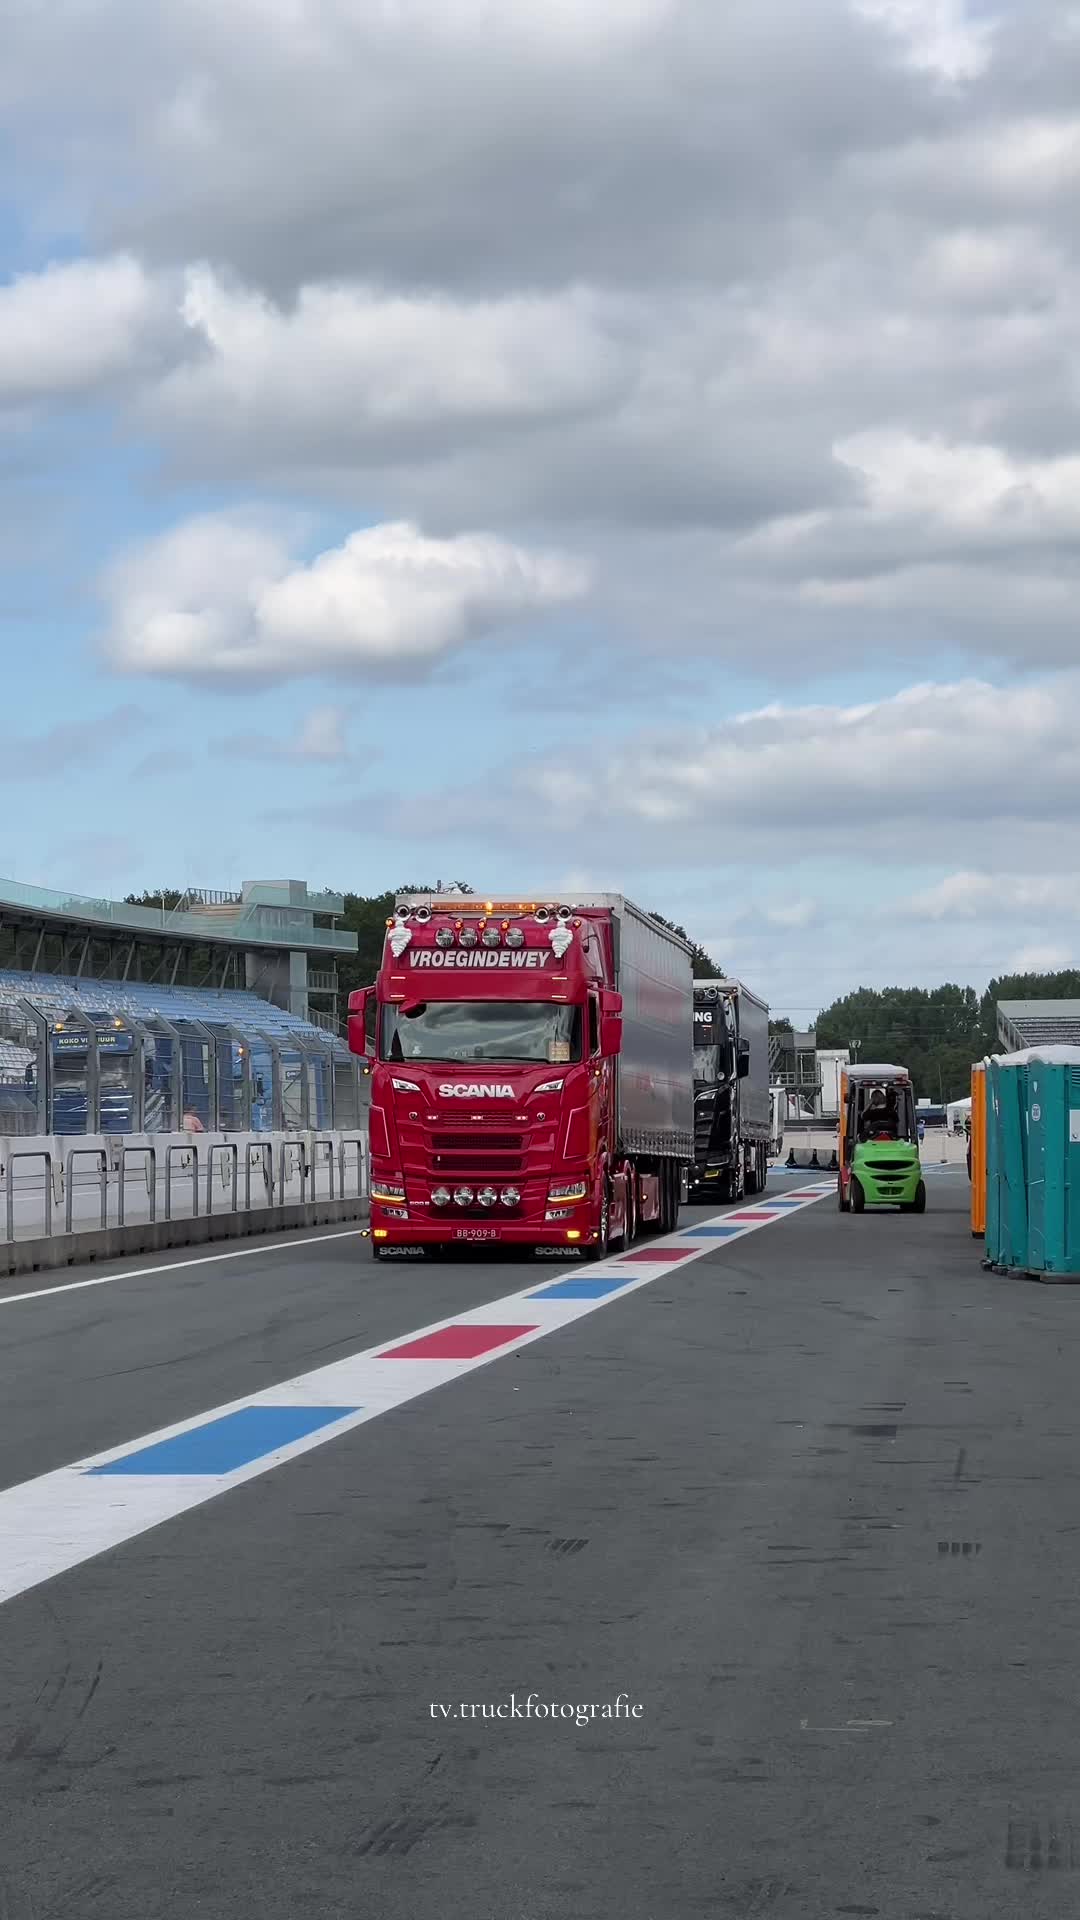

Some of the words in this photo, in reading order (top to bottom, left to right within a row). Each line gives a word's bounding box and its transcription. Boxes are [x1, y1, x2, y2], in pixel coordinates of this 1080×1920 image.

[409, 950, 550, 967] VROEGINDEWEY
[438, 1083, 516, 1098] SCANIA
[379, 1246, 425, 1256] SCANIA
[535, 1246, 581, 1256] SCANIA
